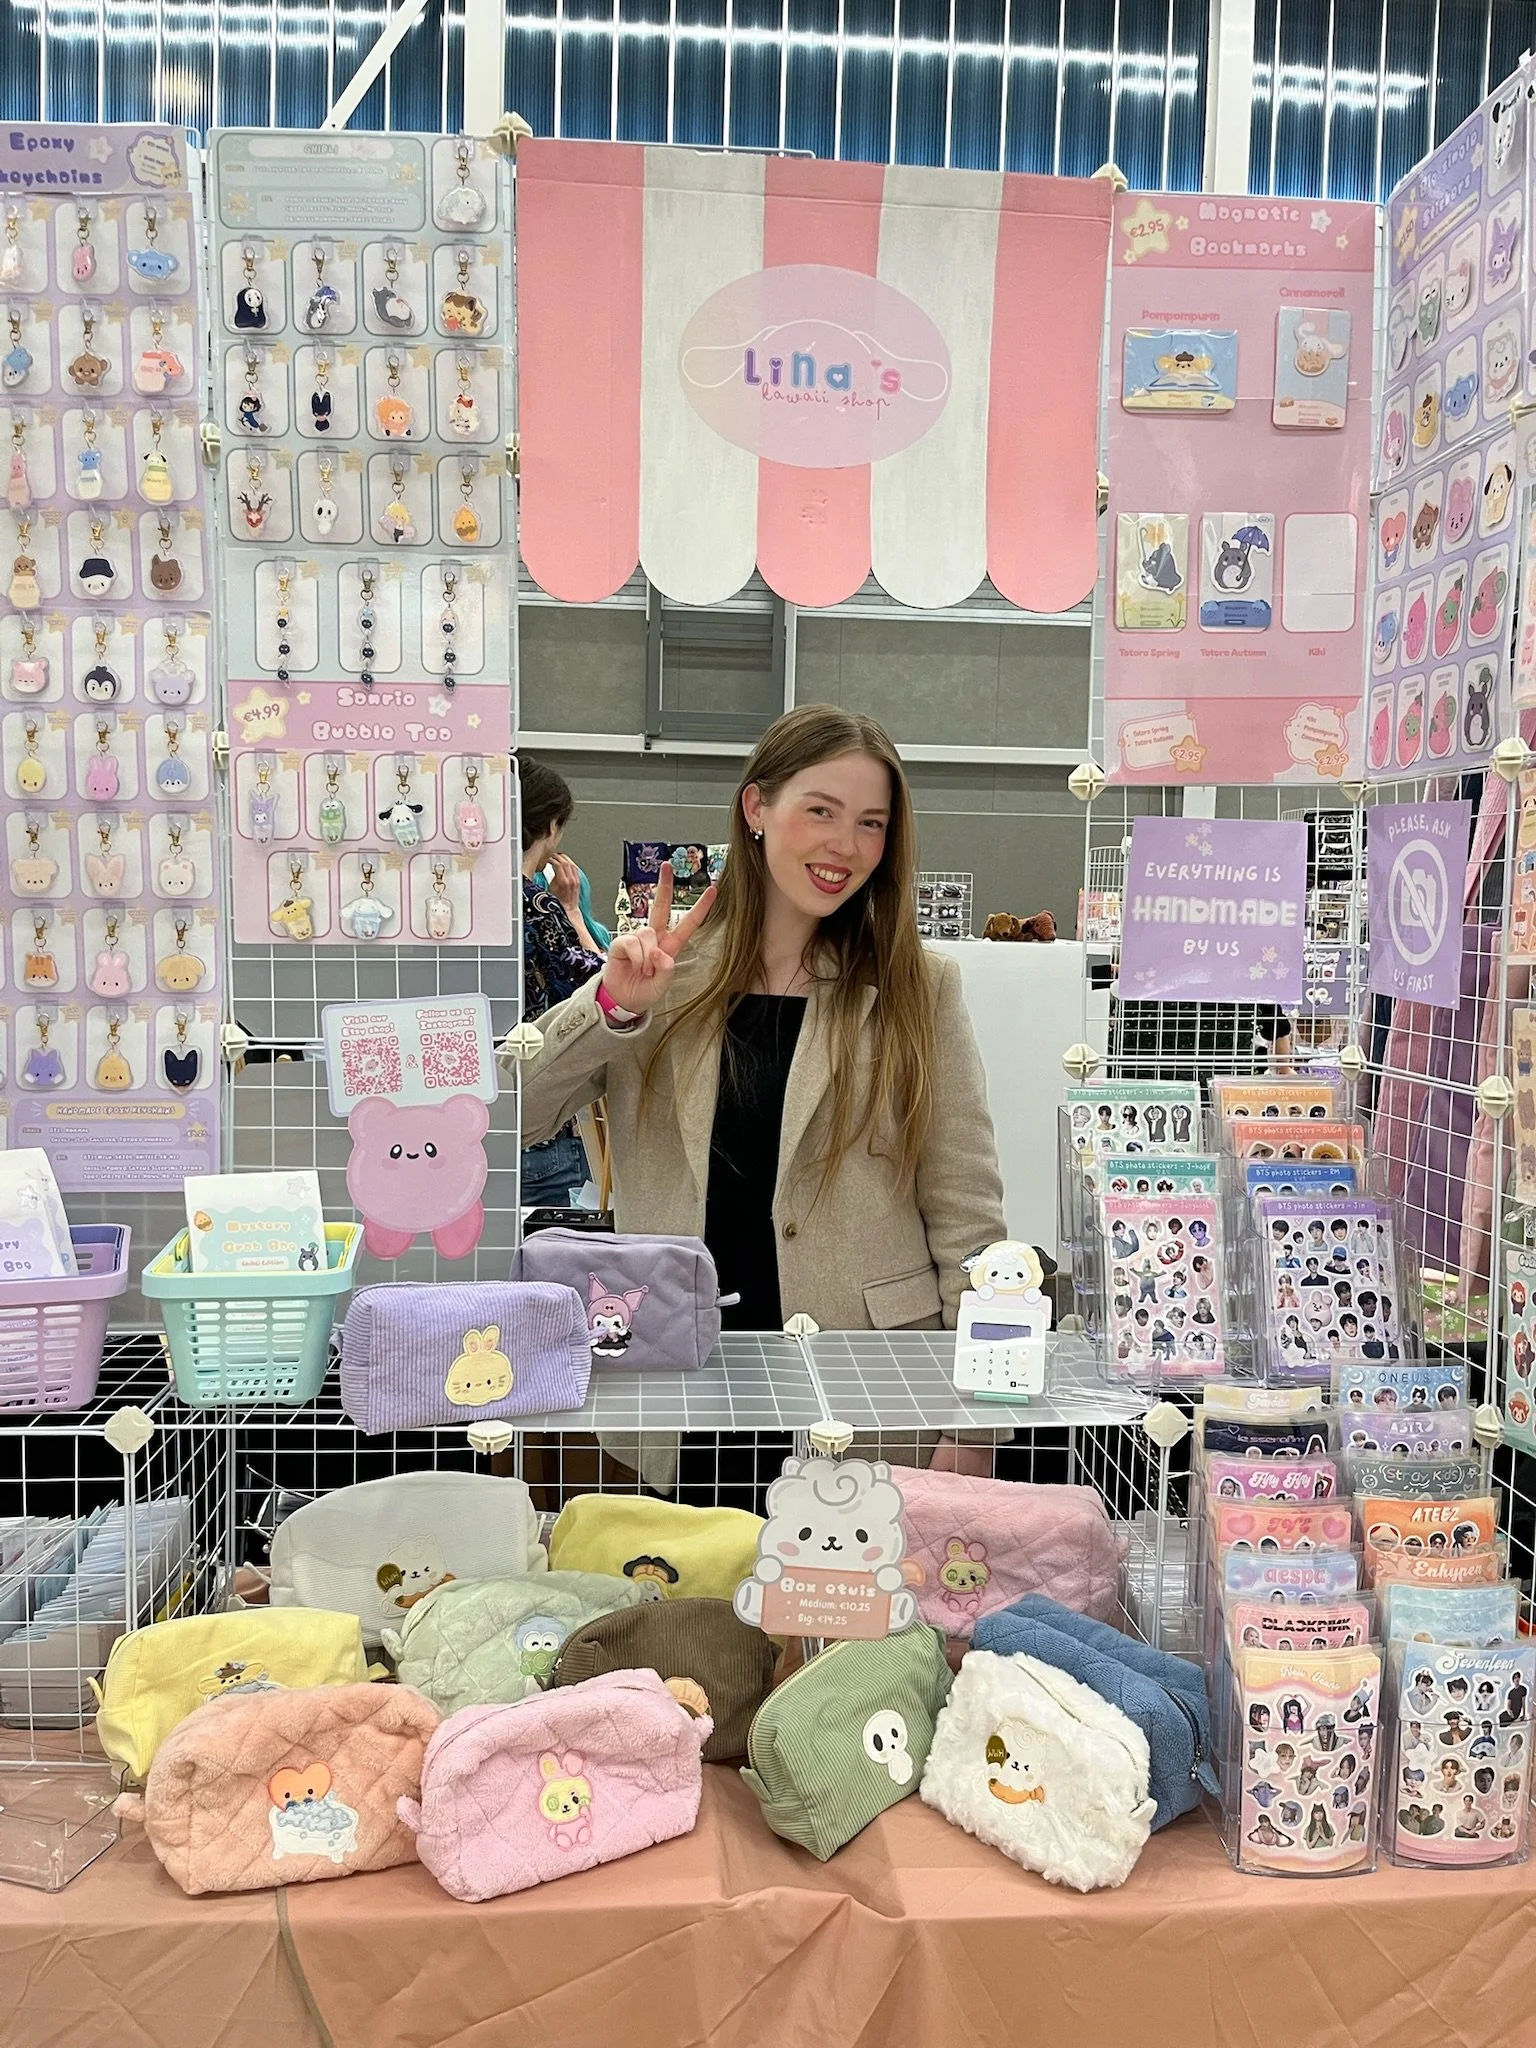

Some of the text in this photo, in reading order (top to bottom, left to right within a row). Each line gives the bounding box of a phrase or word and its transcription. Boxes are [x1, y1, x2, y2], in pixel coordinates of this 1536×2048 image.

[9, 132, 75, 152] Epoxy
[1199, 203, 1300, 224] Magnetic
[1130, 219, 1164, 238] €2.95
[1190, 236, 1307, 256] Bookmarks
[1279, 287, 1345, 298] Cinnamoroll
[1142, 310, 1220, 323] Pompompurin
[841, 391, 890, 420] shop
[1119, 648, 1180, 659] Totoro Spring
[1200, 648, 1267, 657] Totoro Autumn
[1308, 647, 1326, 657] Kiki
[336, 686, 416, 707] Sanrio
[243, 703, 281, 722] €4.99
[312, 721, 452, 742] Bubble Tea
[1173, 749, 1201, 762] €2.95
[1319, 753, 1347, 766] €2.95
[1431, 818, 1452, 839] ASK
[1145, 862, 1281, 883] EVERYTHING IS
[1132, 895, 1298, 928] HANDMADE
[1183, 939, 1240, 956] BY US
[1393, 972, 1435, 992] US FIRST
[342, 1014, 388, 1025] Visit our
[416, 1007, 476, 1019] Follow us on
[342, 1022, 395, 1037] Etsy shop!
[419, 1016, 474, 1030] Instagram!
[405, 1054, 419, 1069] &
[56, 1106, 176, 1115] HANDMADE EPOXY KEYCHAINS
[1264, 1127, 1283, 1135] photo
[1109, 1161, 1124, 1169] BTS
[1125, 1162, 1146, 1170] photo
[1148, 1162, 1178, 1170] stickers
[1256, 1169, 1270, 1177] BTS
[1272, 1169, 1291, 1178] photo
[1278, 1202, 1292, 1210] BTS
[1293, 1202, 1313, 1211] photo
[1315, 1202, 1345, 1210] stickers
[226, 1221, 290, 1233] Mystery
[223, 1239, 297, 1254] Grab Bag
[1378, 1372, 1432, 1383] ONEUS
[1390, 1421, 1435, 1433] ASTRO
[1387, 1468, 1458, 1481] Stray Kids
[1411, 1507, 1461, 1523] ATEEZ
[1264, 1567, 1326, 1588] aespa
[1412, 1561, 1483, 1582] Enhypen
[780, 1577, 877, 1597] Box etuis
[799, 1598, 871, 1611] Medium: €10.25
[797, 1613, 815, 1624] Big:
[1262, 1617, 1351, 1632] BLACKPINK
[1435, 1649, 1515, 1674] Seventeen
[1280, 1665, 1341, 1690] New Jeans
